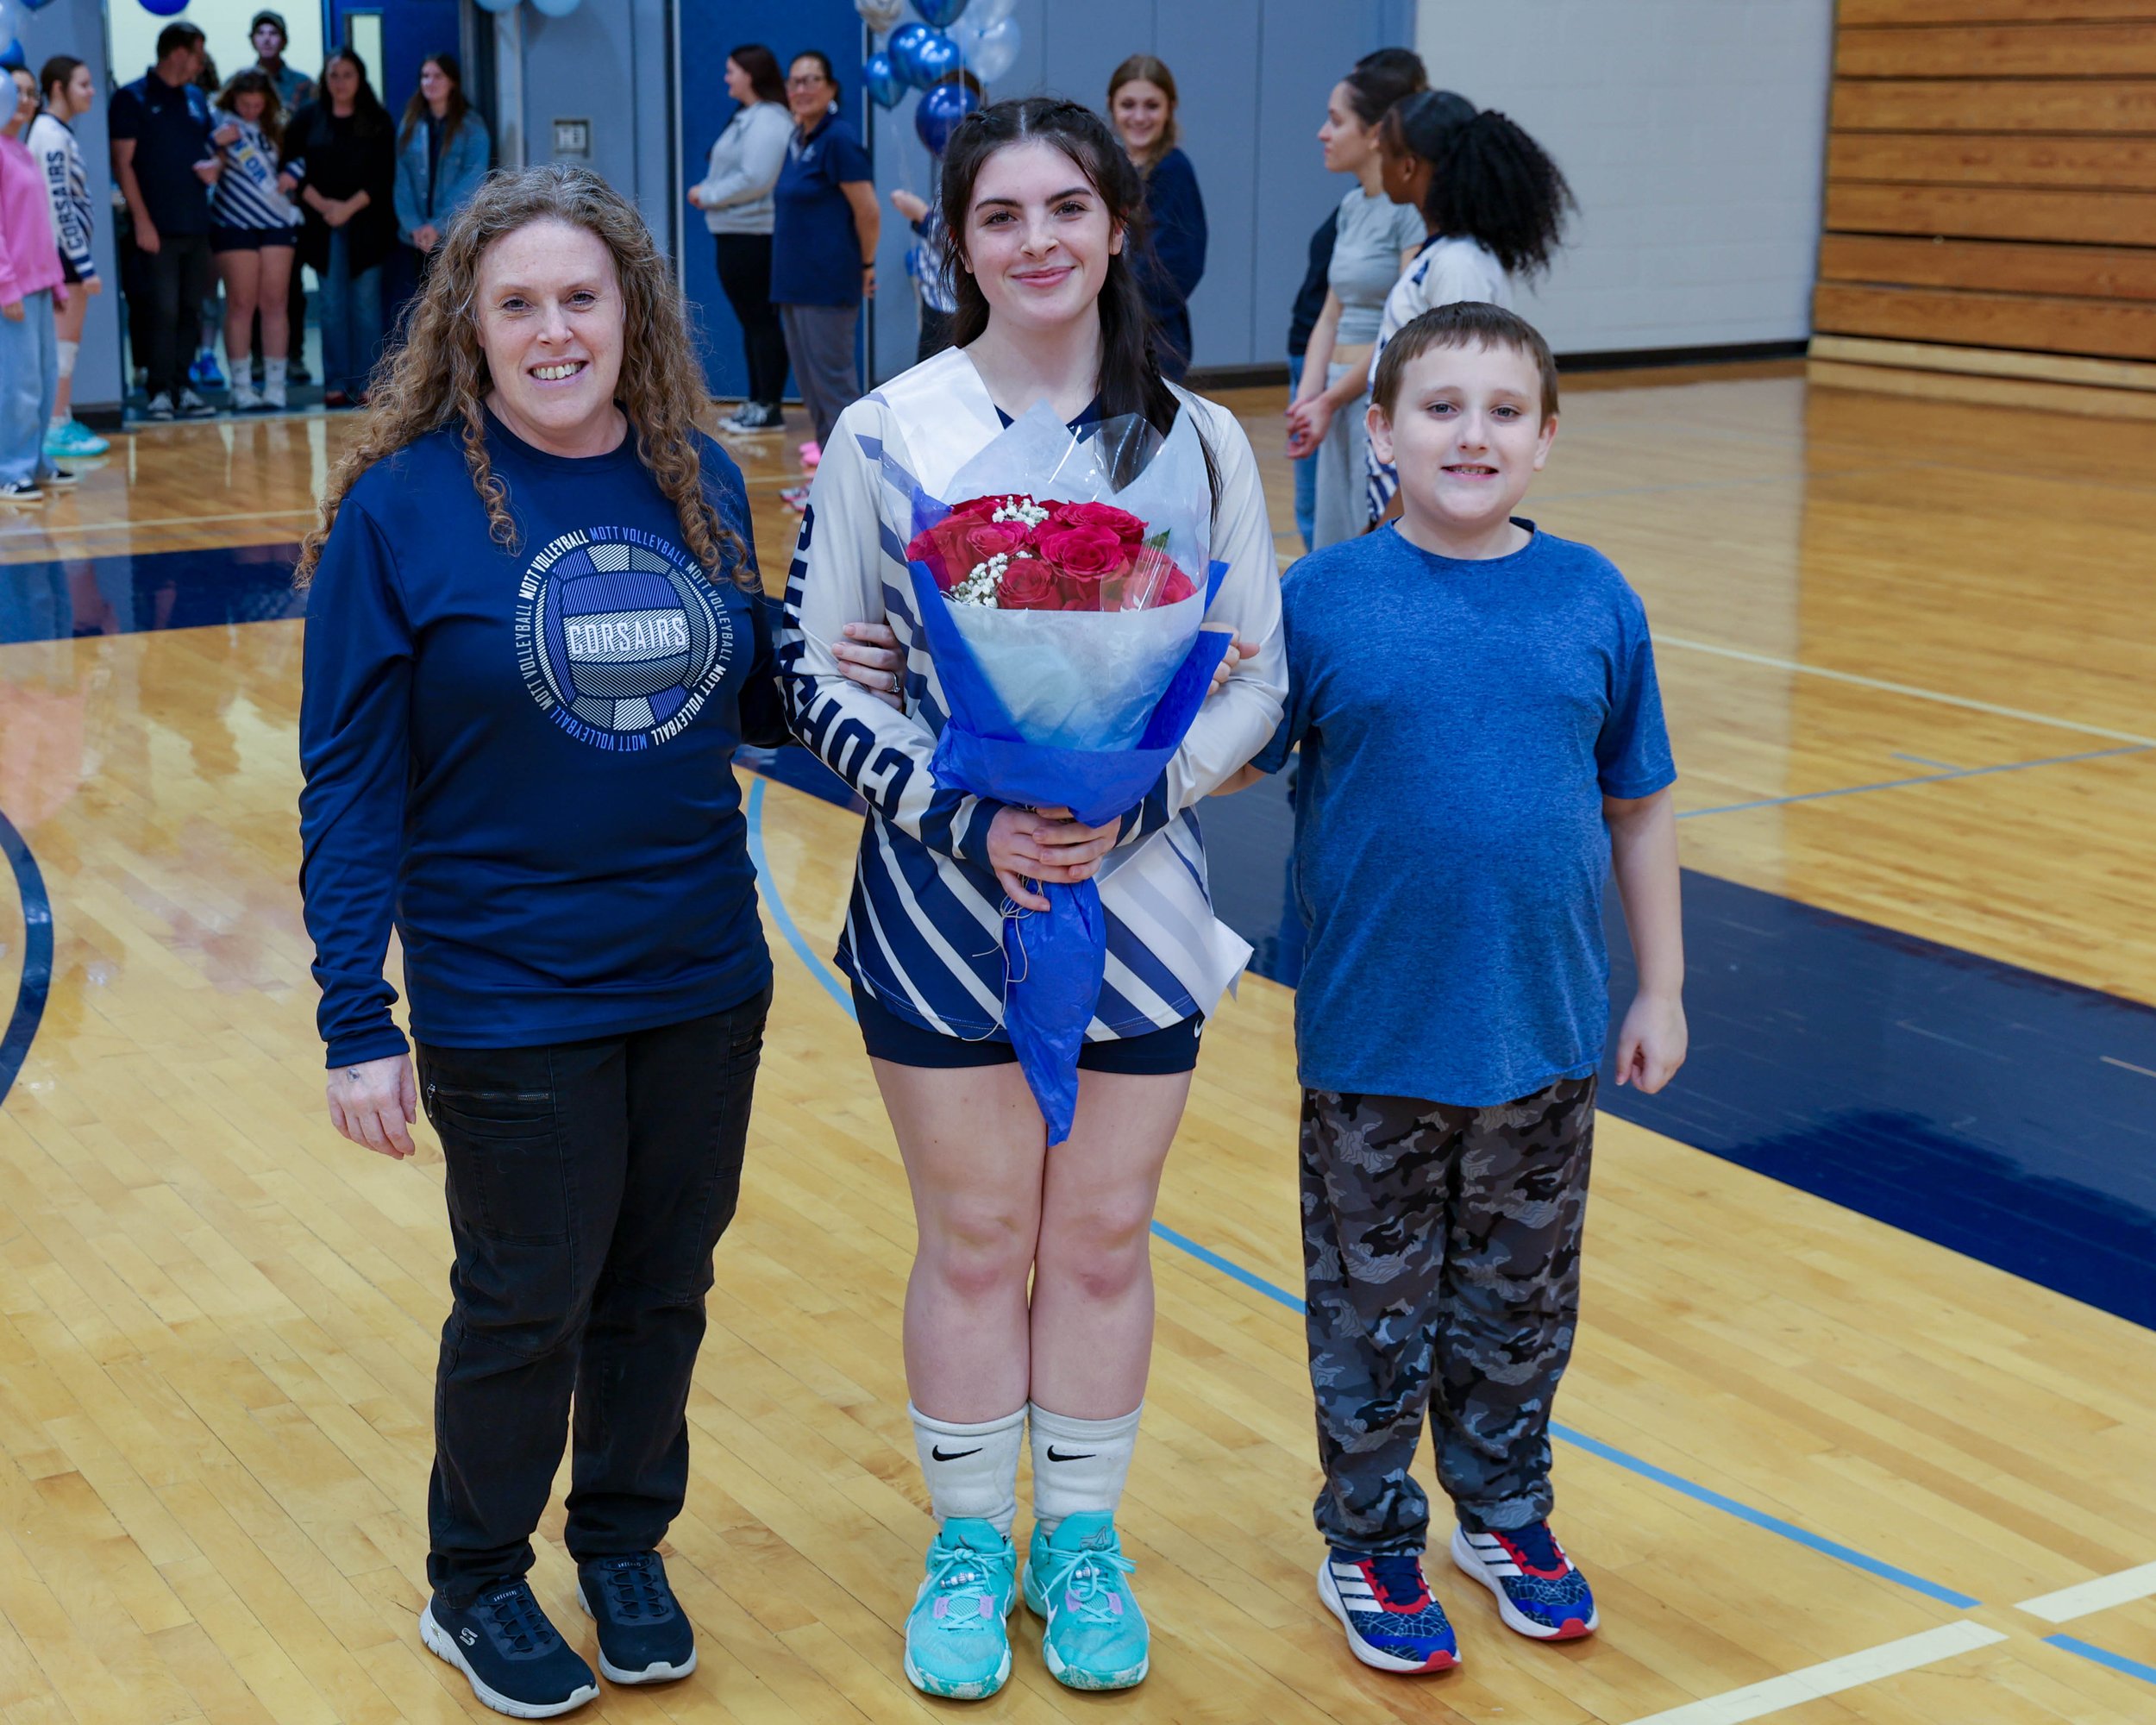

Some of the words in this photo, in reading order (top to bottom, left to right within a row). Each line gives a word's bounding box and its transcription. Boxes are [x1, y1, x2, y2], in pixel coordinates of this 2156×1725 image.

[47, 150, 85, 251] CORSAIRS
[518, 568, 542, 600] MOTT
[530, 529, 589, 573] VOLLEYBALL
[589, 526, 618, 542] MOTT
[623, 527, 686, 566] VOLLEYBALL
[686, 561, 711, 590] MOTT
[707, 590, 733, 662] VOLLEYBALL
[515, 604, 538, 680] VOLLEYBALL
[568, 617, 686, 655] CORSAIRS
[527, 679, 555, 711] MOTT
[700, 663, 726, 696] MOTT
[550, 705, 614, 750] VOLLEYBALL
[651, 693, 705, 746] VOLLEYBALL
[618, 734, 647, 751] MOTT
